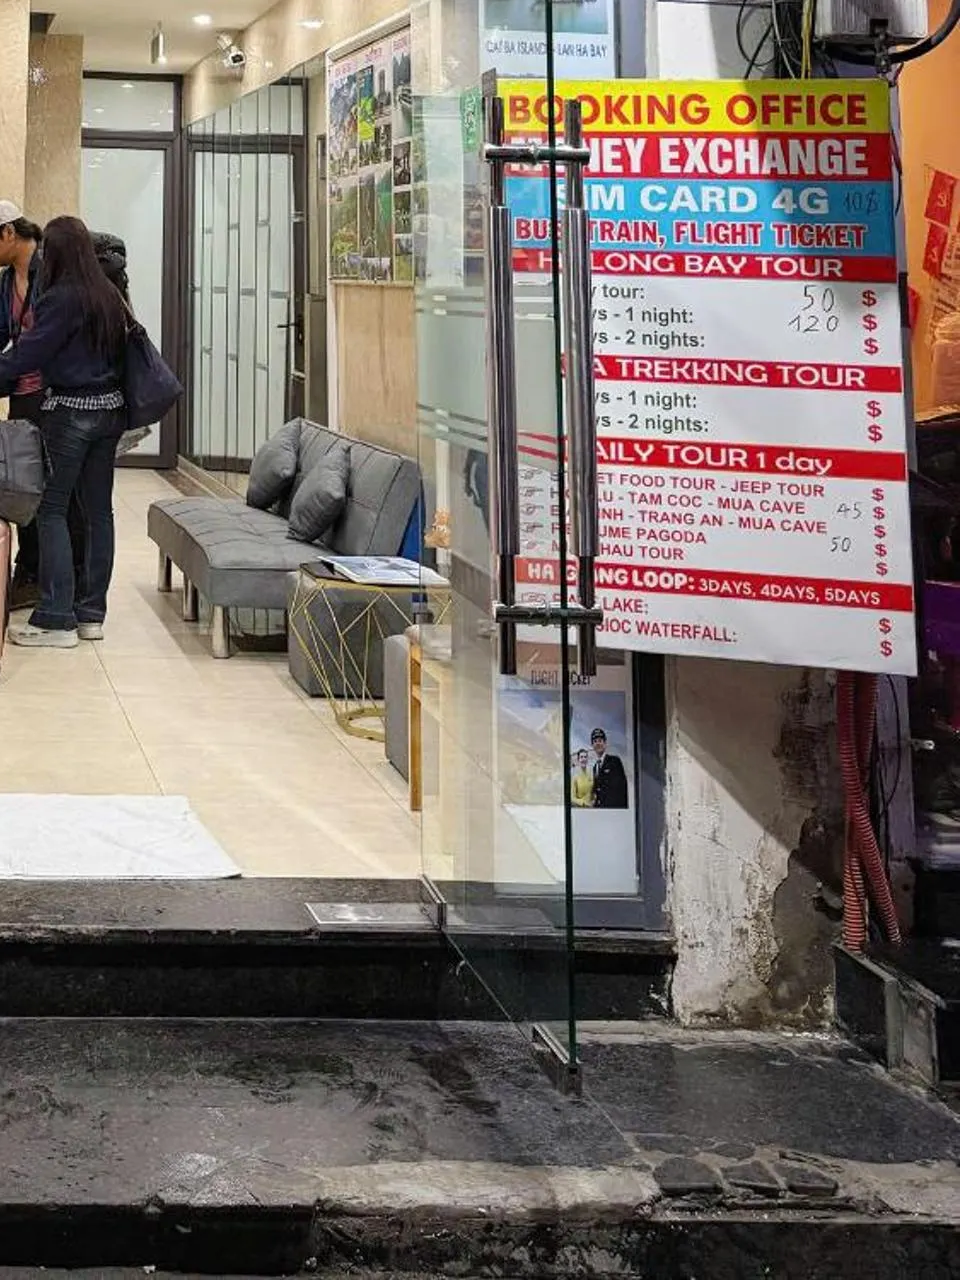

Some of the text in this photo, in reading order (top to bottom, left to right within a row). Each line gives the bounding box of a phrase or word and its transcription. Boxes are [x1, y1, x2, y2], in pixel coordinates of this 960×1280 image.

[508, 93, 711, 125] BOOKING
[726, 93, 867, 126] OFFICE
[658, 136, 869, 176] EXCHANGE
[640, 184, 758, 213] CARD
[771, 186, 829, 215] 4G
[673, 220, 765, 247] FLIGHT
[771, 222, 868, 249] TICKET
[590, 252, 675, 272] LONG
[685, 254, 748, 275] BAY
[755, 256, 843, 277] TOUR
[602, 284, 645, 300] tour:
[801, 284, 835, 313] 50
[861, 289, 877, 308] $
[625, 306, 634, 321] 1
[641, 307, 694, 327] night:
[788, 314, 840, 333] 120
[862, 313, 878, 332] $
[625, 329, 635, 345] 2
[642, 329, 705, 350] nights:
[863, 336, 879, 356] $
[615, 358, 768, 384] TREKKING
[775, 364, 866, 388] TOUR
[628, 390, 636, 405] 1
[644, 391, 697, 411] night:
[866, 399, 882, 419] $
[628, 414, 639, 430] 2
[645, 414, 709, 435] nights:
[867, 423, 883, 444] $
[596, 440, 833, 476] AILY TOUR 1 day
[620, 473, 665, 488] FOOD
[670, 476, 716, 491] TOUR
[730, 478, 772, 494] JEEP
[777, 482, 825, 498] TOUR
[872, 487, 885, 502] $
[628, 491, 662, 505] TAM
[667, 494, 702, 508] COC
[717, 497, 755, 512] MUA
[759, 499, 806, 515] CAVE
[836, 501, 863, 520] 45
[873, 505, 885, 521] $
[637, 528, 707, 545] PAGODA
[638, 510, 695, 526] TRANG
[699, 514, 723, 527] AN
[738, 516, 776, 532] MUA
[781, 519, 827, 535] CAVE
[874, 524, 886, 540] $
[829, 535, 852, 553] 50
[875, 542, 887, 558] $
[600, 545, 888, 577] HAU TOUR $
[527, 562, 555, 581] HA
[632, 570, 696, 591] LOOP:
[698, 578, 757, 598] 3DAYS,
[760, 583, 820, 603] 4DAYS,
[824, 587, 881, 606] 5DAYS
[603, 596, 649, 615] LAKE:
[879, 617, 892, 635] $
[635, 620, 738, 644] WATERFALL:
[880, 639, 893, 657] $
